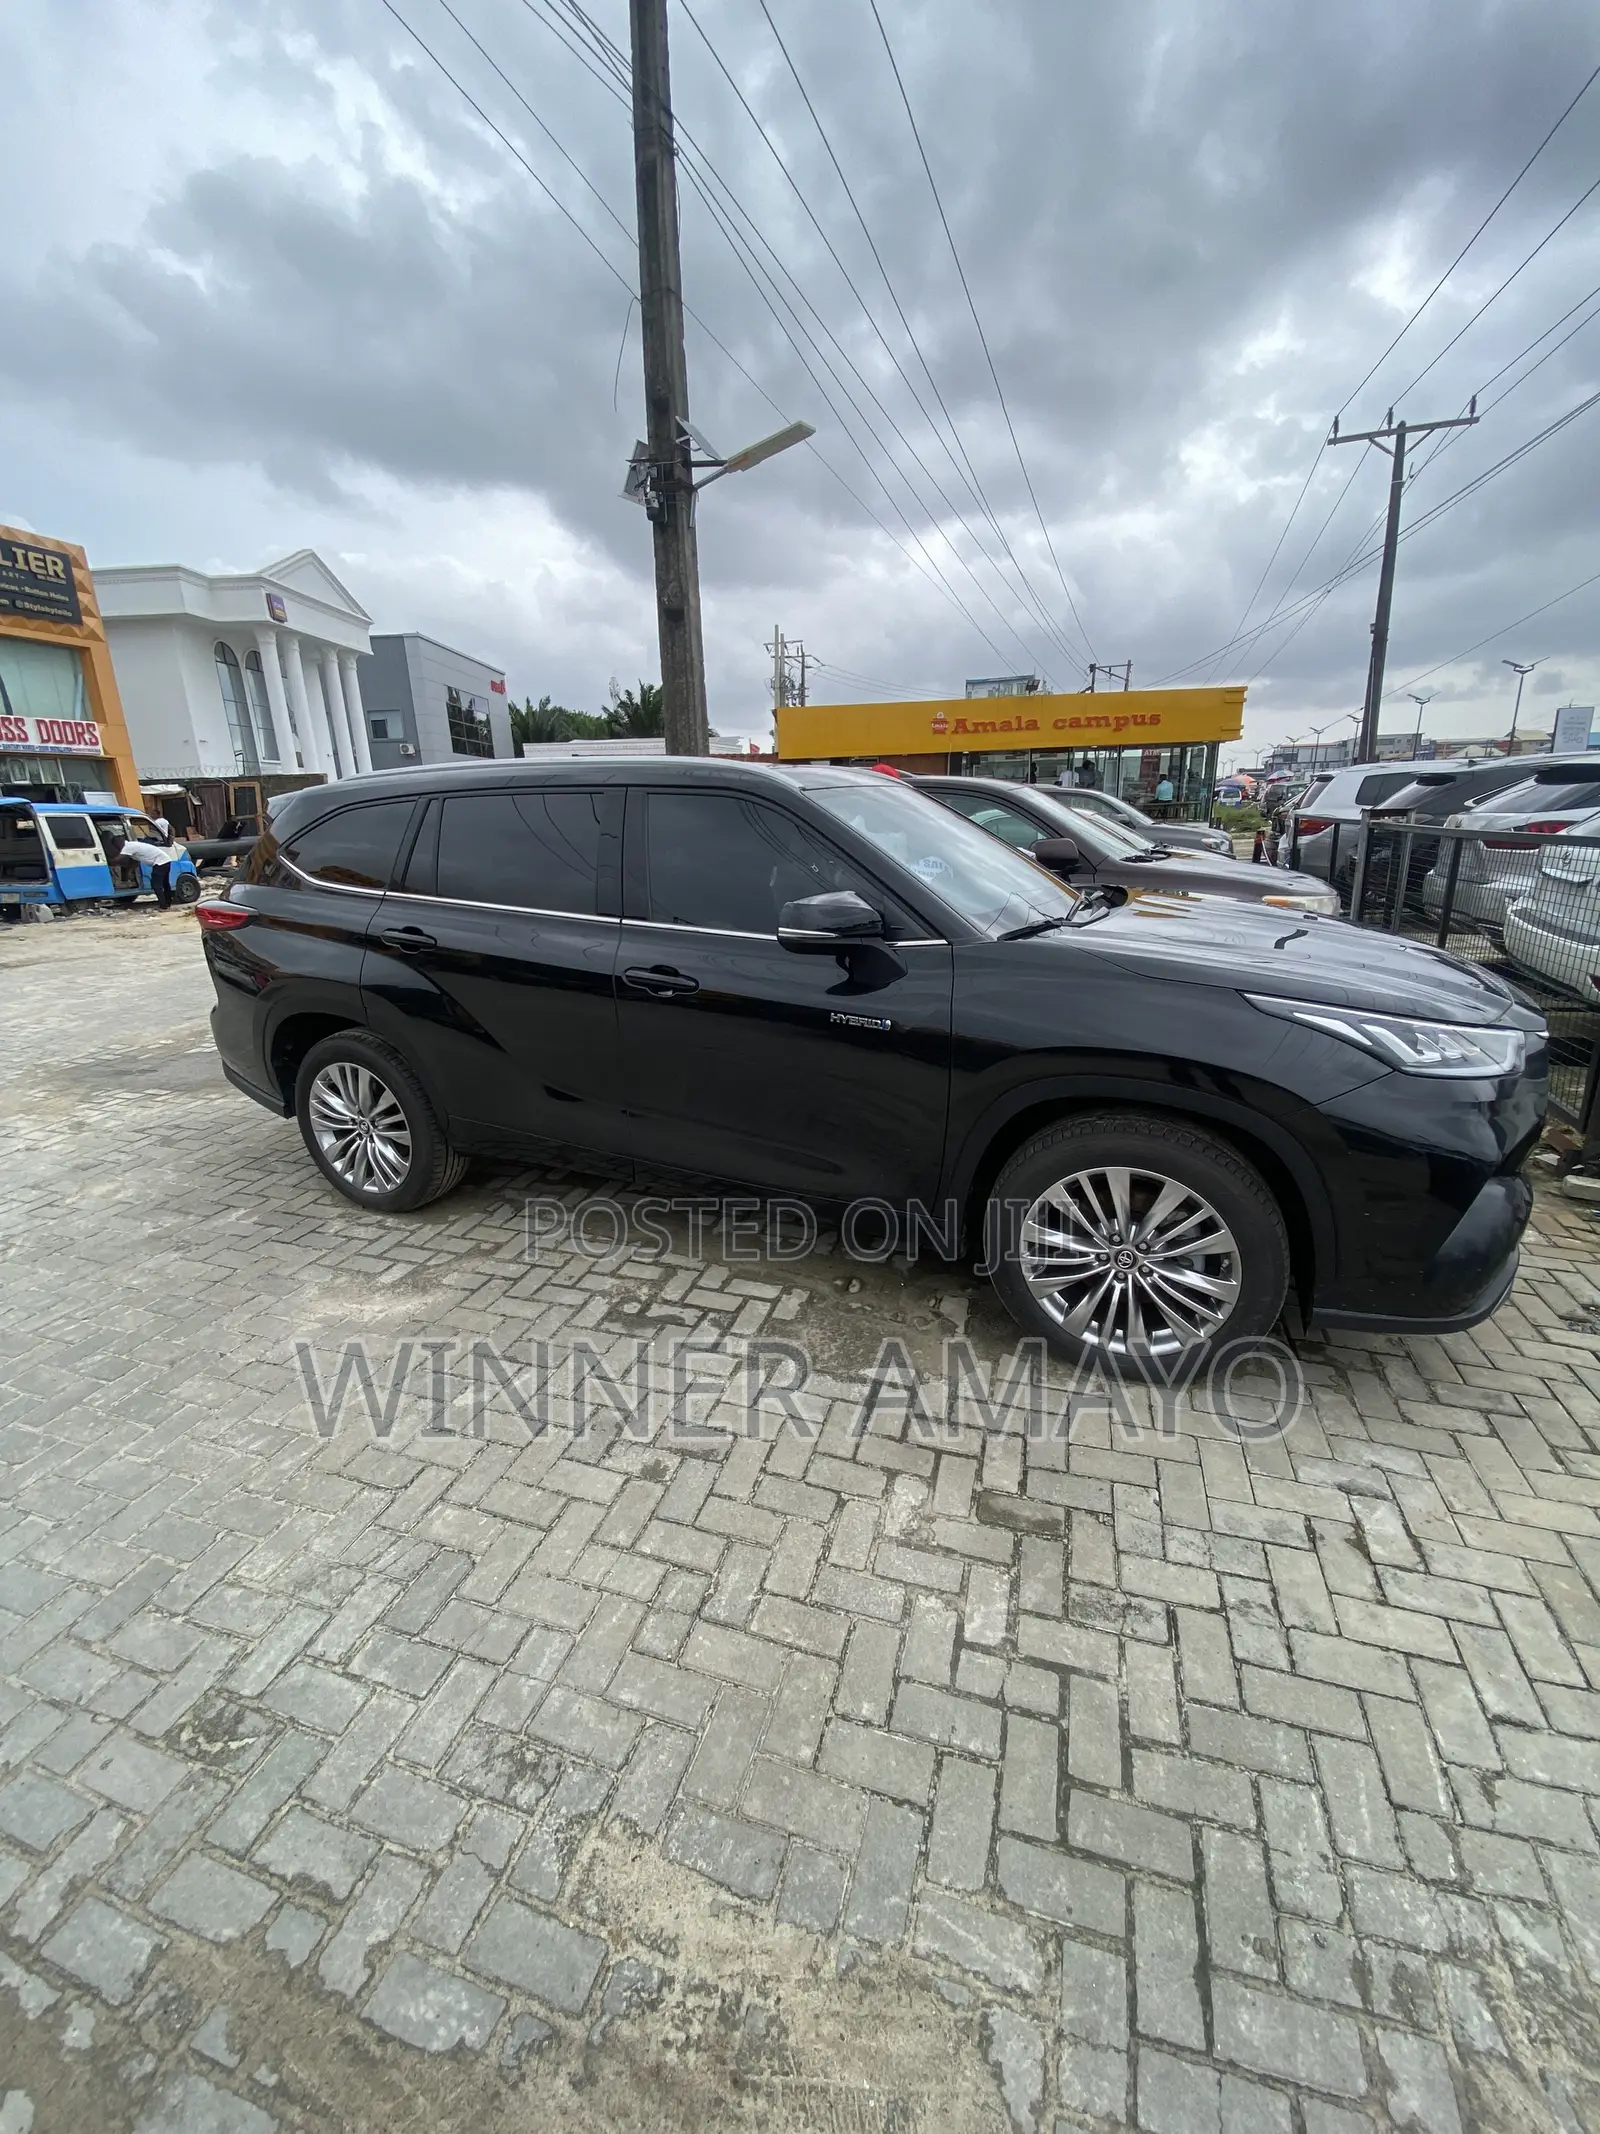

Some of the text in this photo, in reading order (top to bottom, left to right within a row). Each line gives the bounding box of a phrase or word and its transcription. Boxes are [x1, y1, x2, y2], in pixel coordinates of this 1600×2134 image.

[0, 716, 100, 746] SS DOORS
[951, 713, 1162, 735] Amala campus
[830, 1012, 883, 1030] HYBRID
